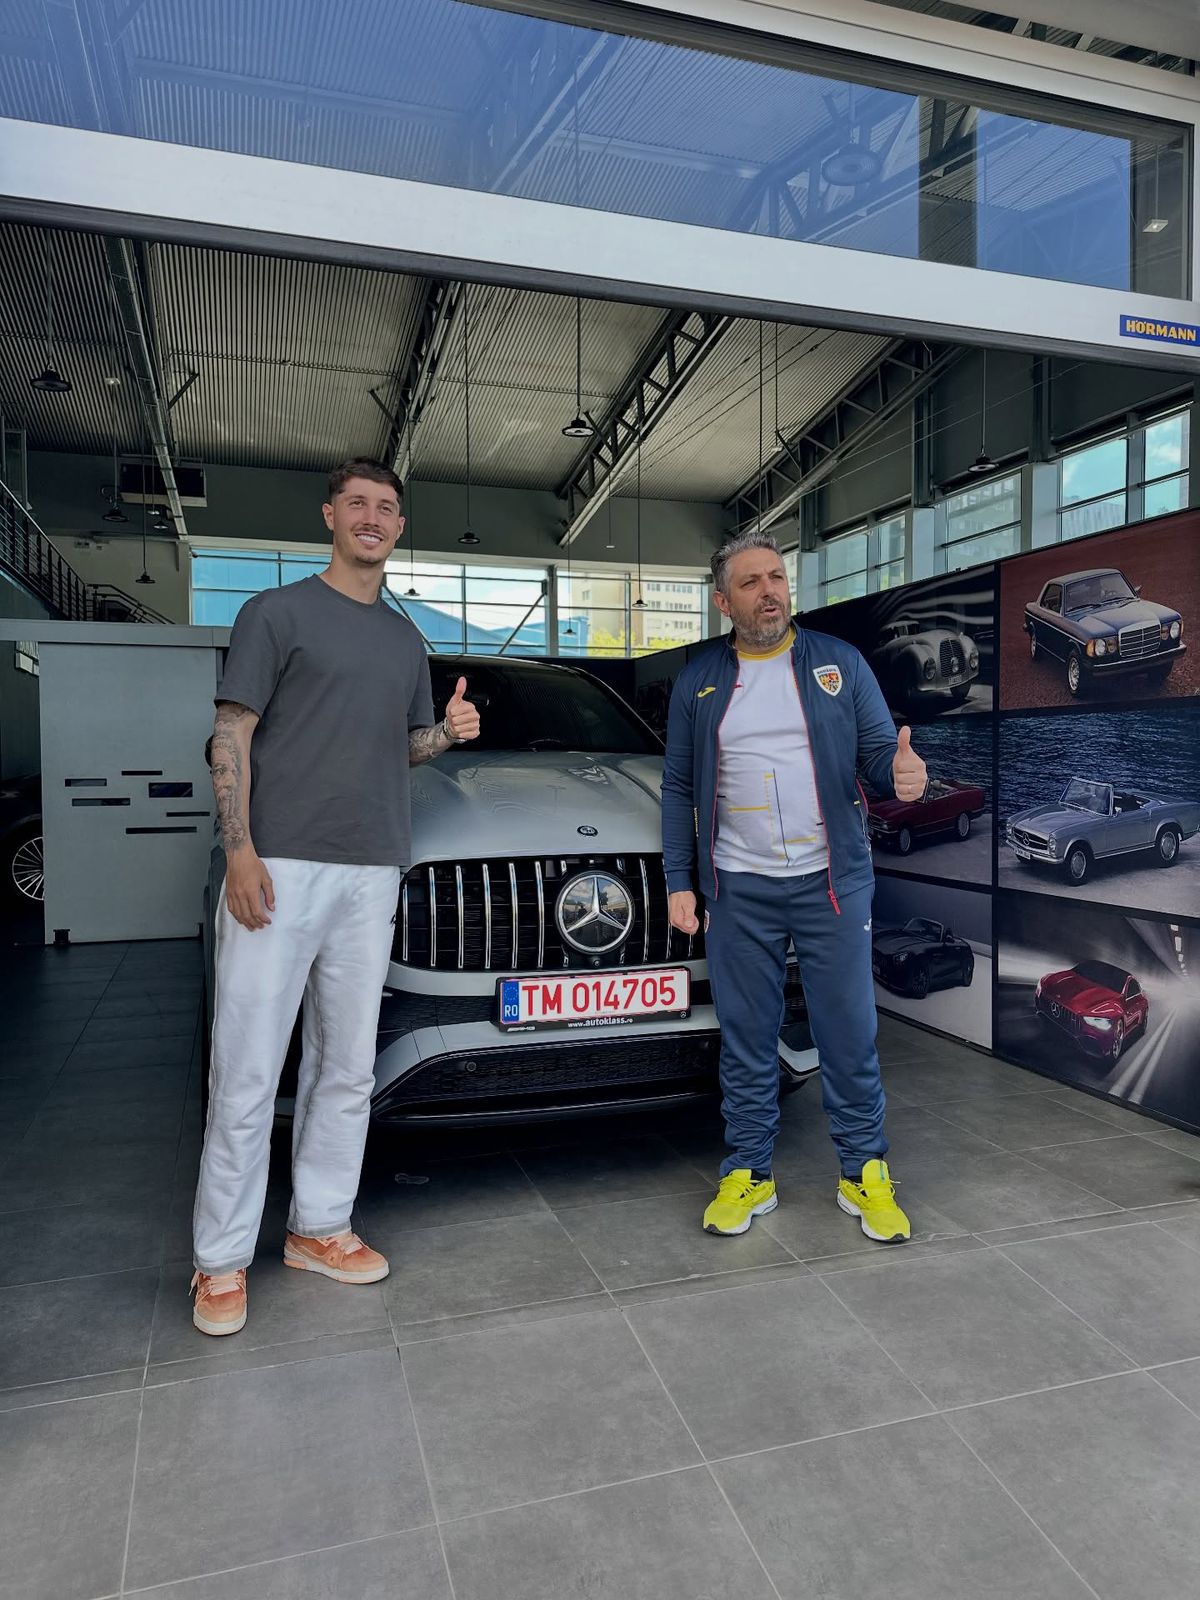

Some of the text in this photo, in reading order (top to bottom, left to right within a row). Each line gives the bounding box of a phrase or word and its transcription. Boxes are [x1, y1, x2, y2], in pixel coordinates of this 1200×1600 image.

[522, 976, 676, 1016] TM 014705
[504, 1004, 518, 1017] RO
[567, 1017, 633, 1028] www.autoklass.ro
